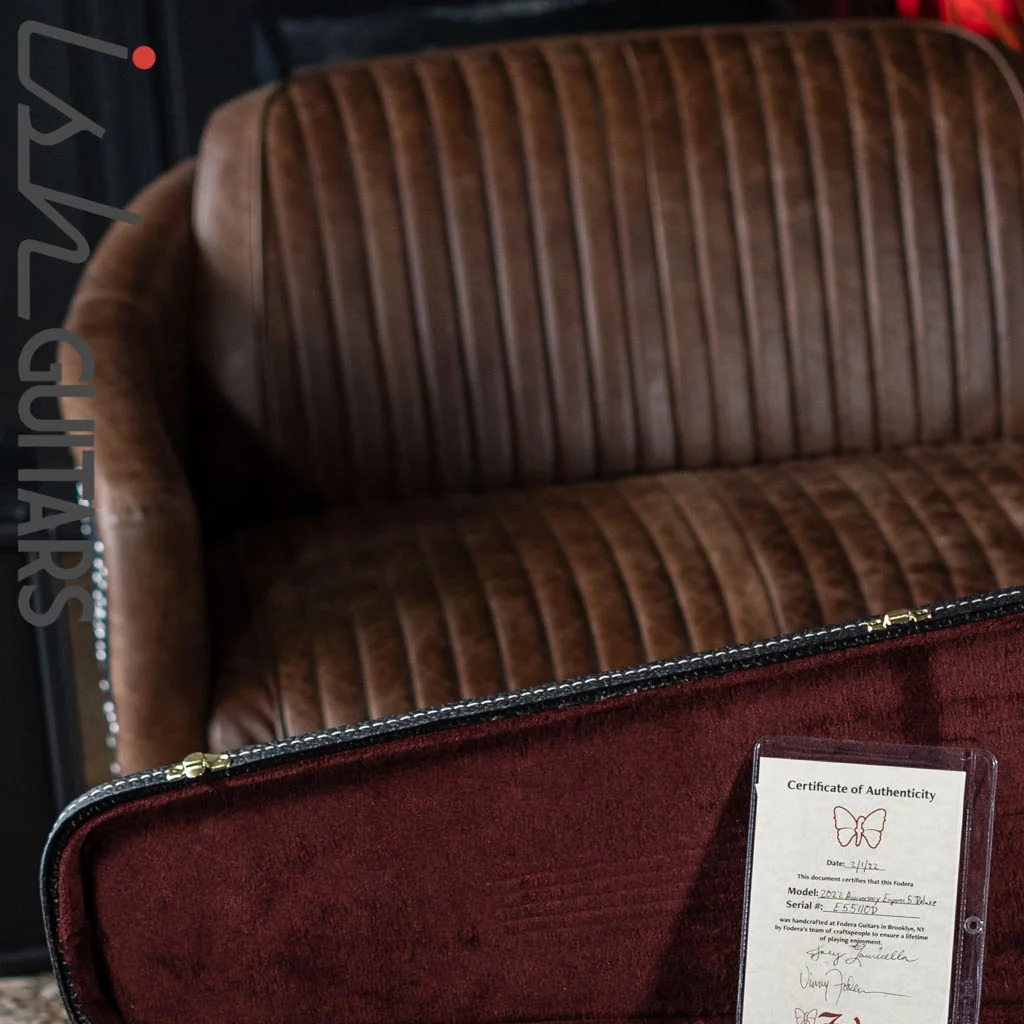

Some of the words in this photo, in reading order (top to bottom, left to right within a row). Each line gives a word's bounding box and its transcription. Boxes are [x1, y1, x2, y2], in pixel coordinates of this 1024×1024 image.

[787, 779, 848, 794] Certificate
[851, 784, 864, 794] of
[866, 786, 936, 803] Authenticity
[826, 859, 845, 867] Date:
[850, 859, 880, 873] 2/1/22
[810, 874, 841, 882] document
[842, 876, 866, 884] certifies
[893, 880, 914, 888] Fodera
[787, 887, 819, 897] Model:
[820, 889, 843, 899] 2022
[786, 900, 813, 910] Serial
[814, 902, 824, 911] #:
[774, 924, 782, 932] by
[833, 929, 871, 937] craftspeople
[792, 917, 828, 926] handcrafted
[836, 920, 857, 928] Fodera
[858, 922, 880, 930] Guitars
[887, 924, 916, 933] Brooklyn,
[827, 936, 849, 944] playing
